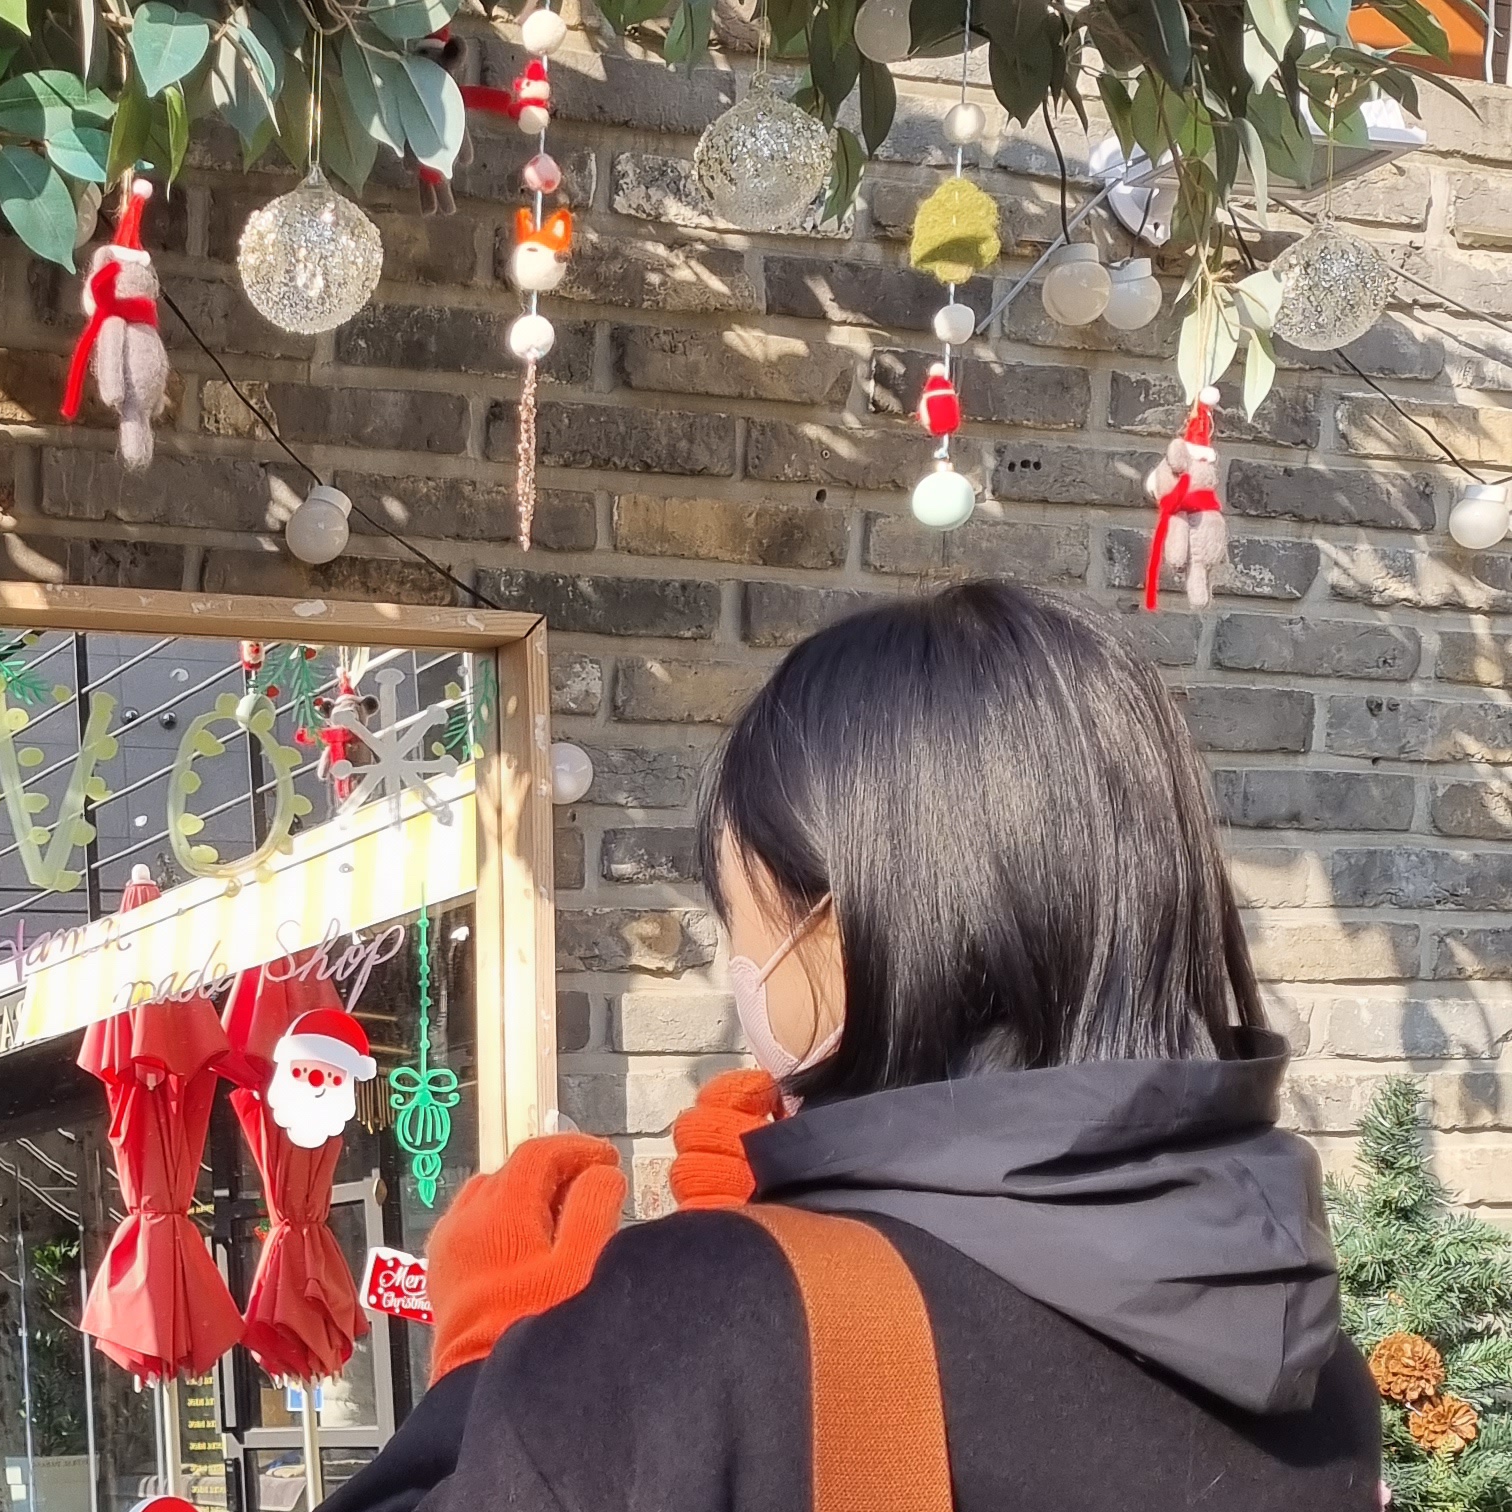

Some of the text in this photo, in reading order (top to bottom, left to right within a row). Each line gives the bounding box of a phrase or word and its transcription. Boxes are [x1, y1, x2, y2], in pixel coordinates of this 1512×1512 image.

[112, 917, 406, 1014] made Shop
[382, 1291, 433, 1312] Christma
